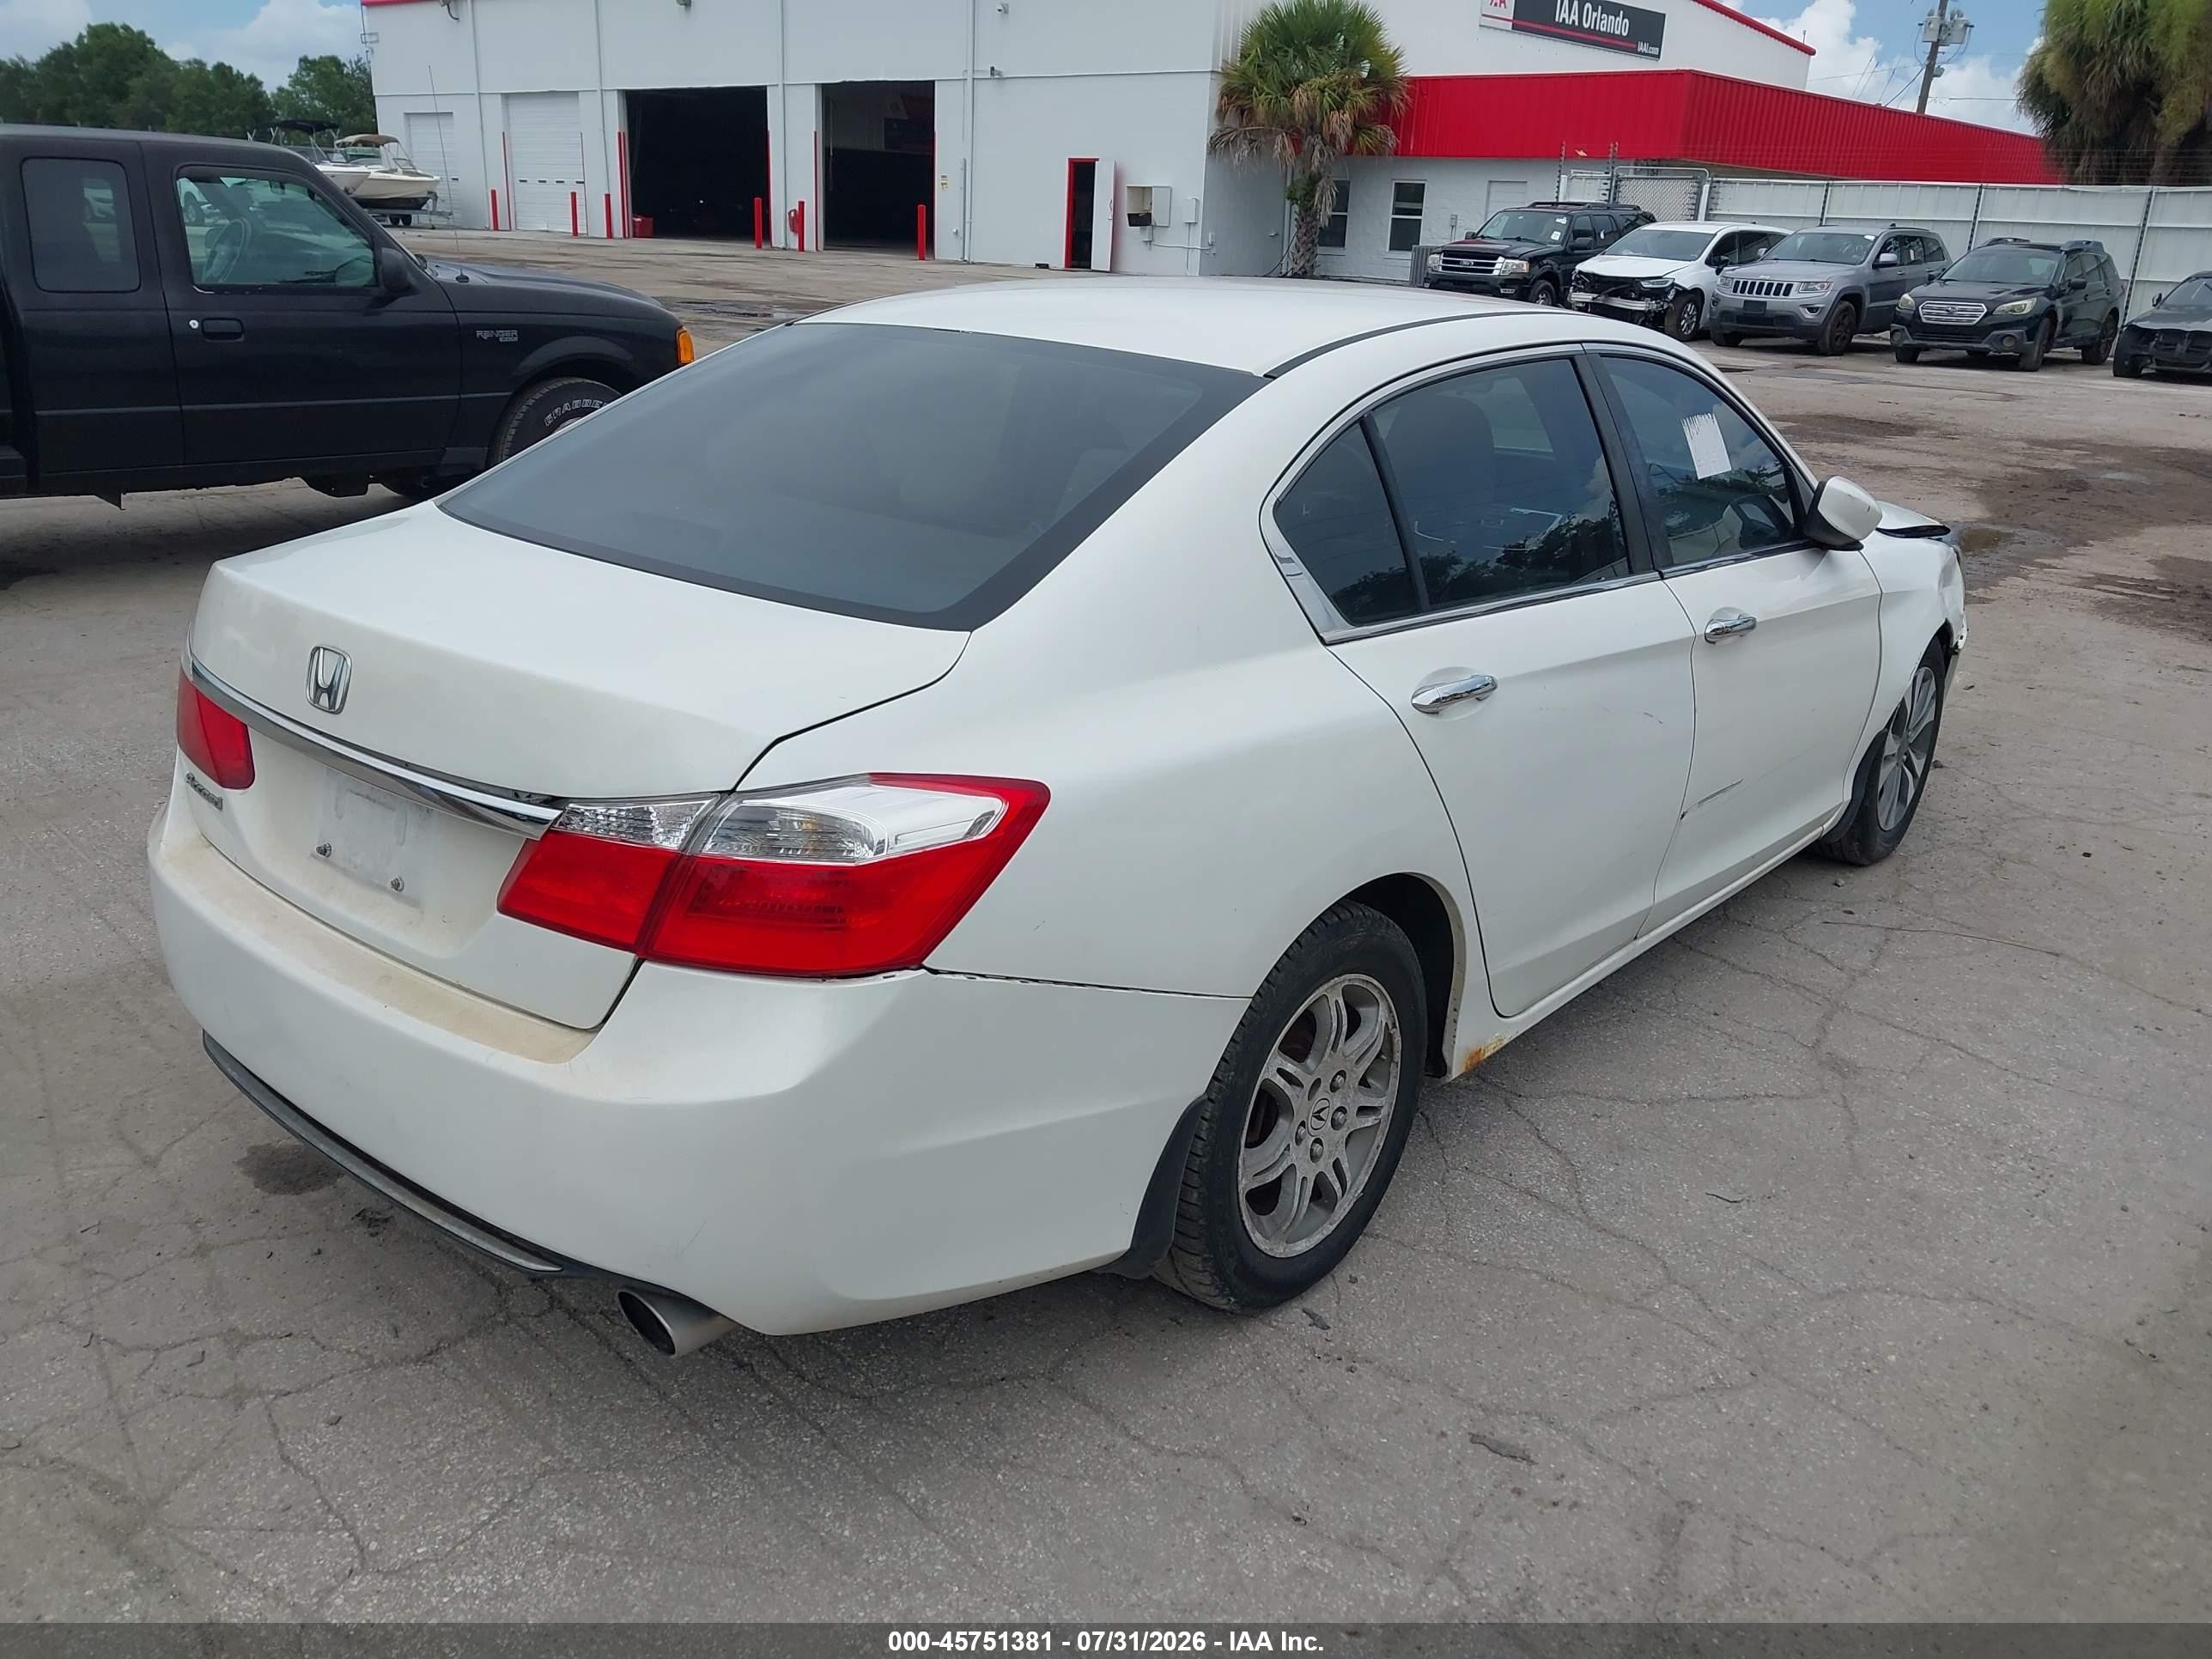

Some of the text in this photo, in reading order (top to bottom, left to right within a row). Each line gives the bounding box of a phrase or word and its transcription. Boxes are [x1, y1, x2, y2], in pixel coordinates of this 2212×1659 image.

[1554, 0, 1630, 37] IAA Orlando
[544, 398, 607, 427] GRABBE
